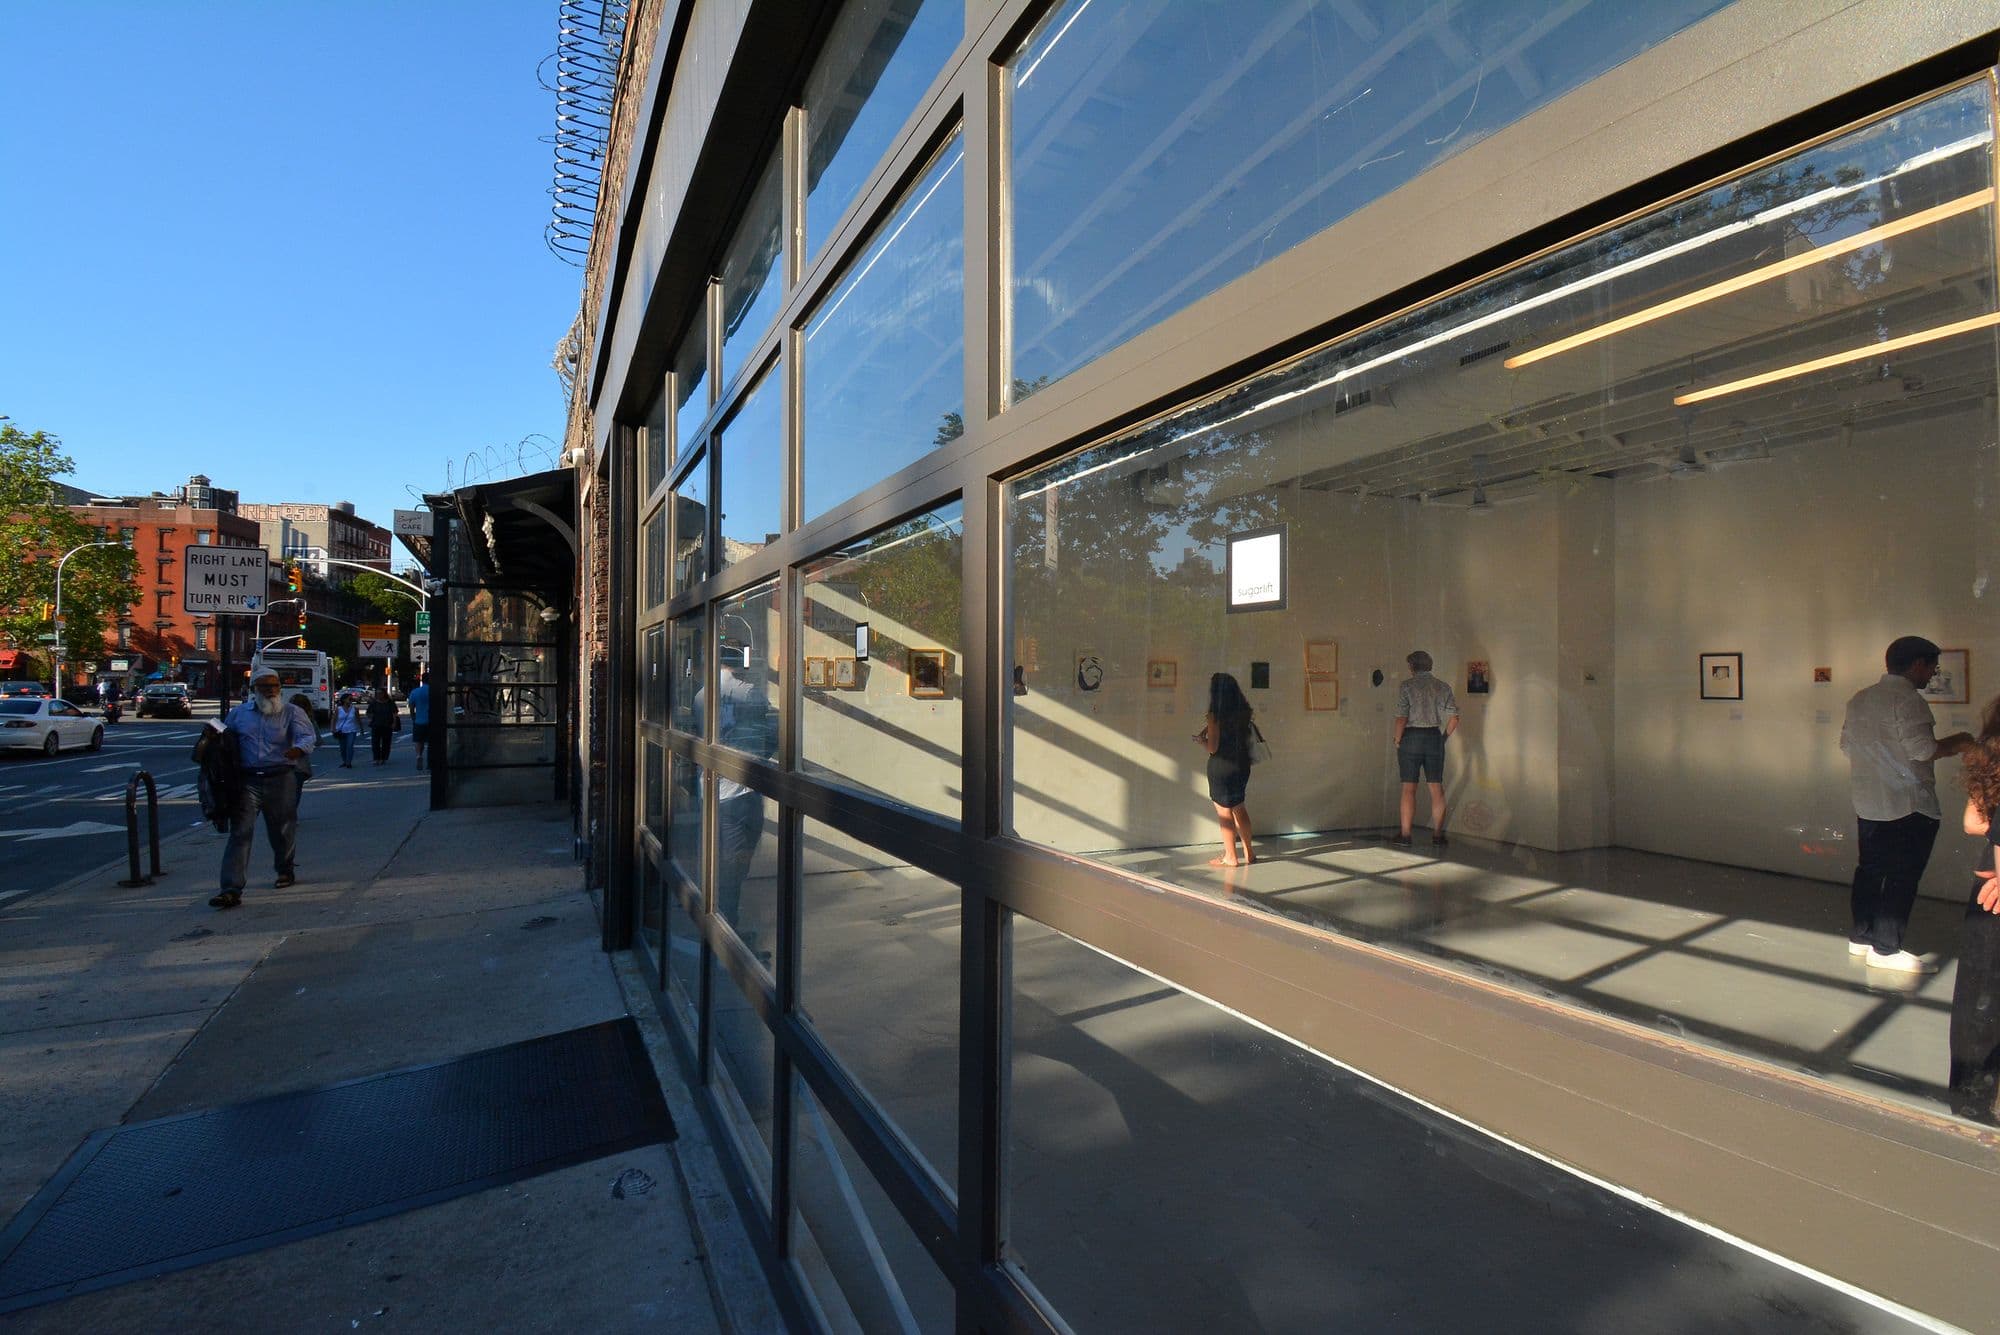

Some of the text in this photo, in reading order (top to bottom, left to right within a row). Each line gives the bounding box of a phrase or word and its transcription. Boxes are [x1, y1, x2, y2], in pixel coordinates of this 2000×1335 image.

[191, 554, 262, 567] RIGHT LANE
[204, 573, 248, 587] MUST
[1238, 584, 1273, 598] sugarlift
[189, 593, 263, 606] TURN RIGT
